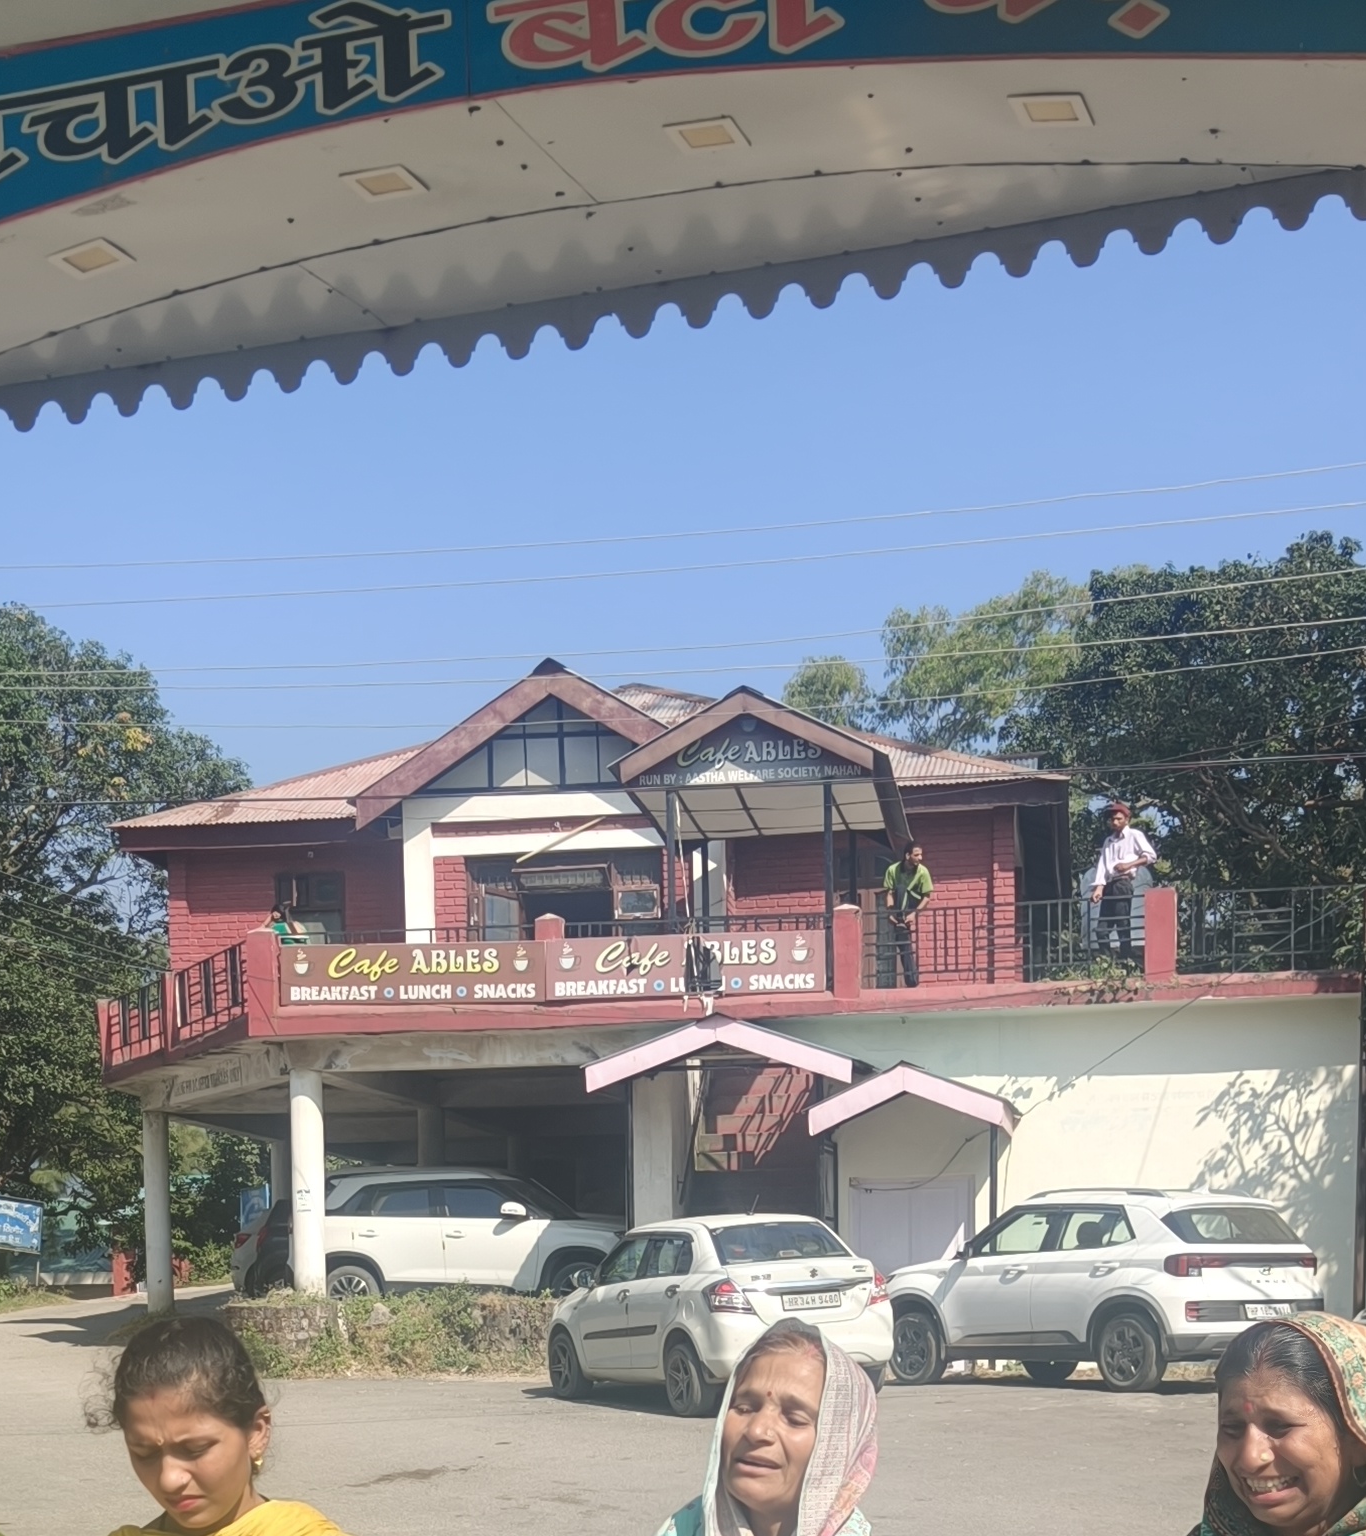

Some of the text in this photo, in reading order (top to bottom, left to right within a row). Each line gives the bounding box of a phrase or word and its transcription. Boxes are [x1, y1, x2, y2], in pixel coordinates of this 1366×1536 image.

[676, 737, 822, 769] Cafe ABLES
[639, 774, 661, 786] RUN
[663, 773, 676, 785] BY
[685, 771, 725, 784] AASTHA
[727, 768, 775, 782] WELFARE
[777, 766, 822, 779] SOCIETY,
[824, 765, 862, 777] NAHAN
[327, 947, 501, 982] Cafe ABLES
[595, 938, 777, 976] Cafe BLES
[290, 983, 536, 1001] BREAKFAST LUNCH SNACKS
[554, 978, 647, 997] BREAKFAST
[749, 973, 815, 991] SNACKS
